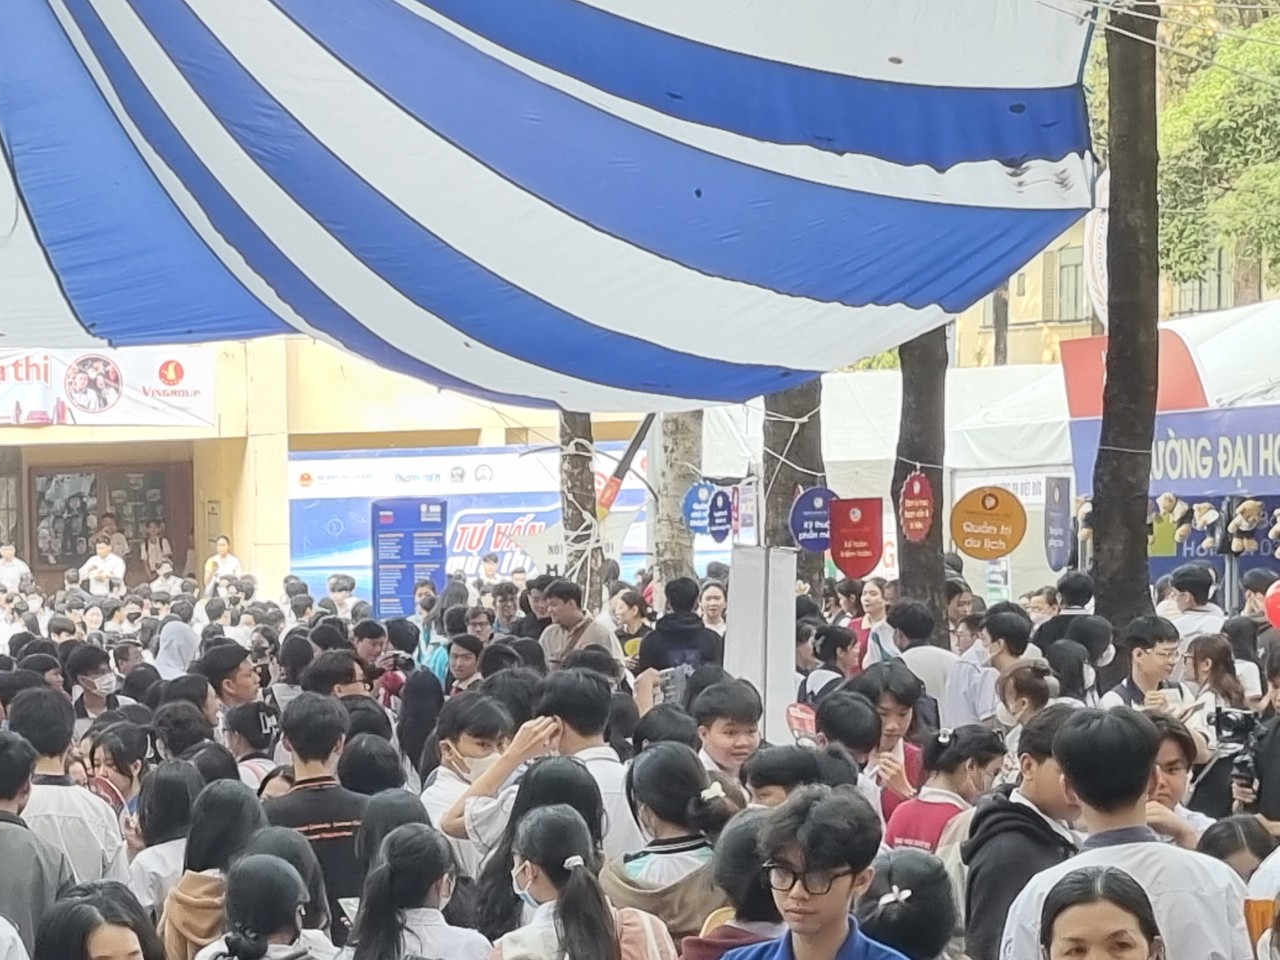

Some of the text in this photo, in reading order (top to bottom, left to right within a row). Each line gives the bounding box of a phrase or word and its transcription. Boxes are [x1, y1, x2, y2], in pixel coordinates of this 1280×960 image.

[11, 354, 49, 384] thi
[1150, 428, 1213, 480] ƯỜNG
[1218, 434, 1253, 488] ĐẠI
